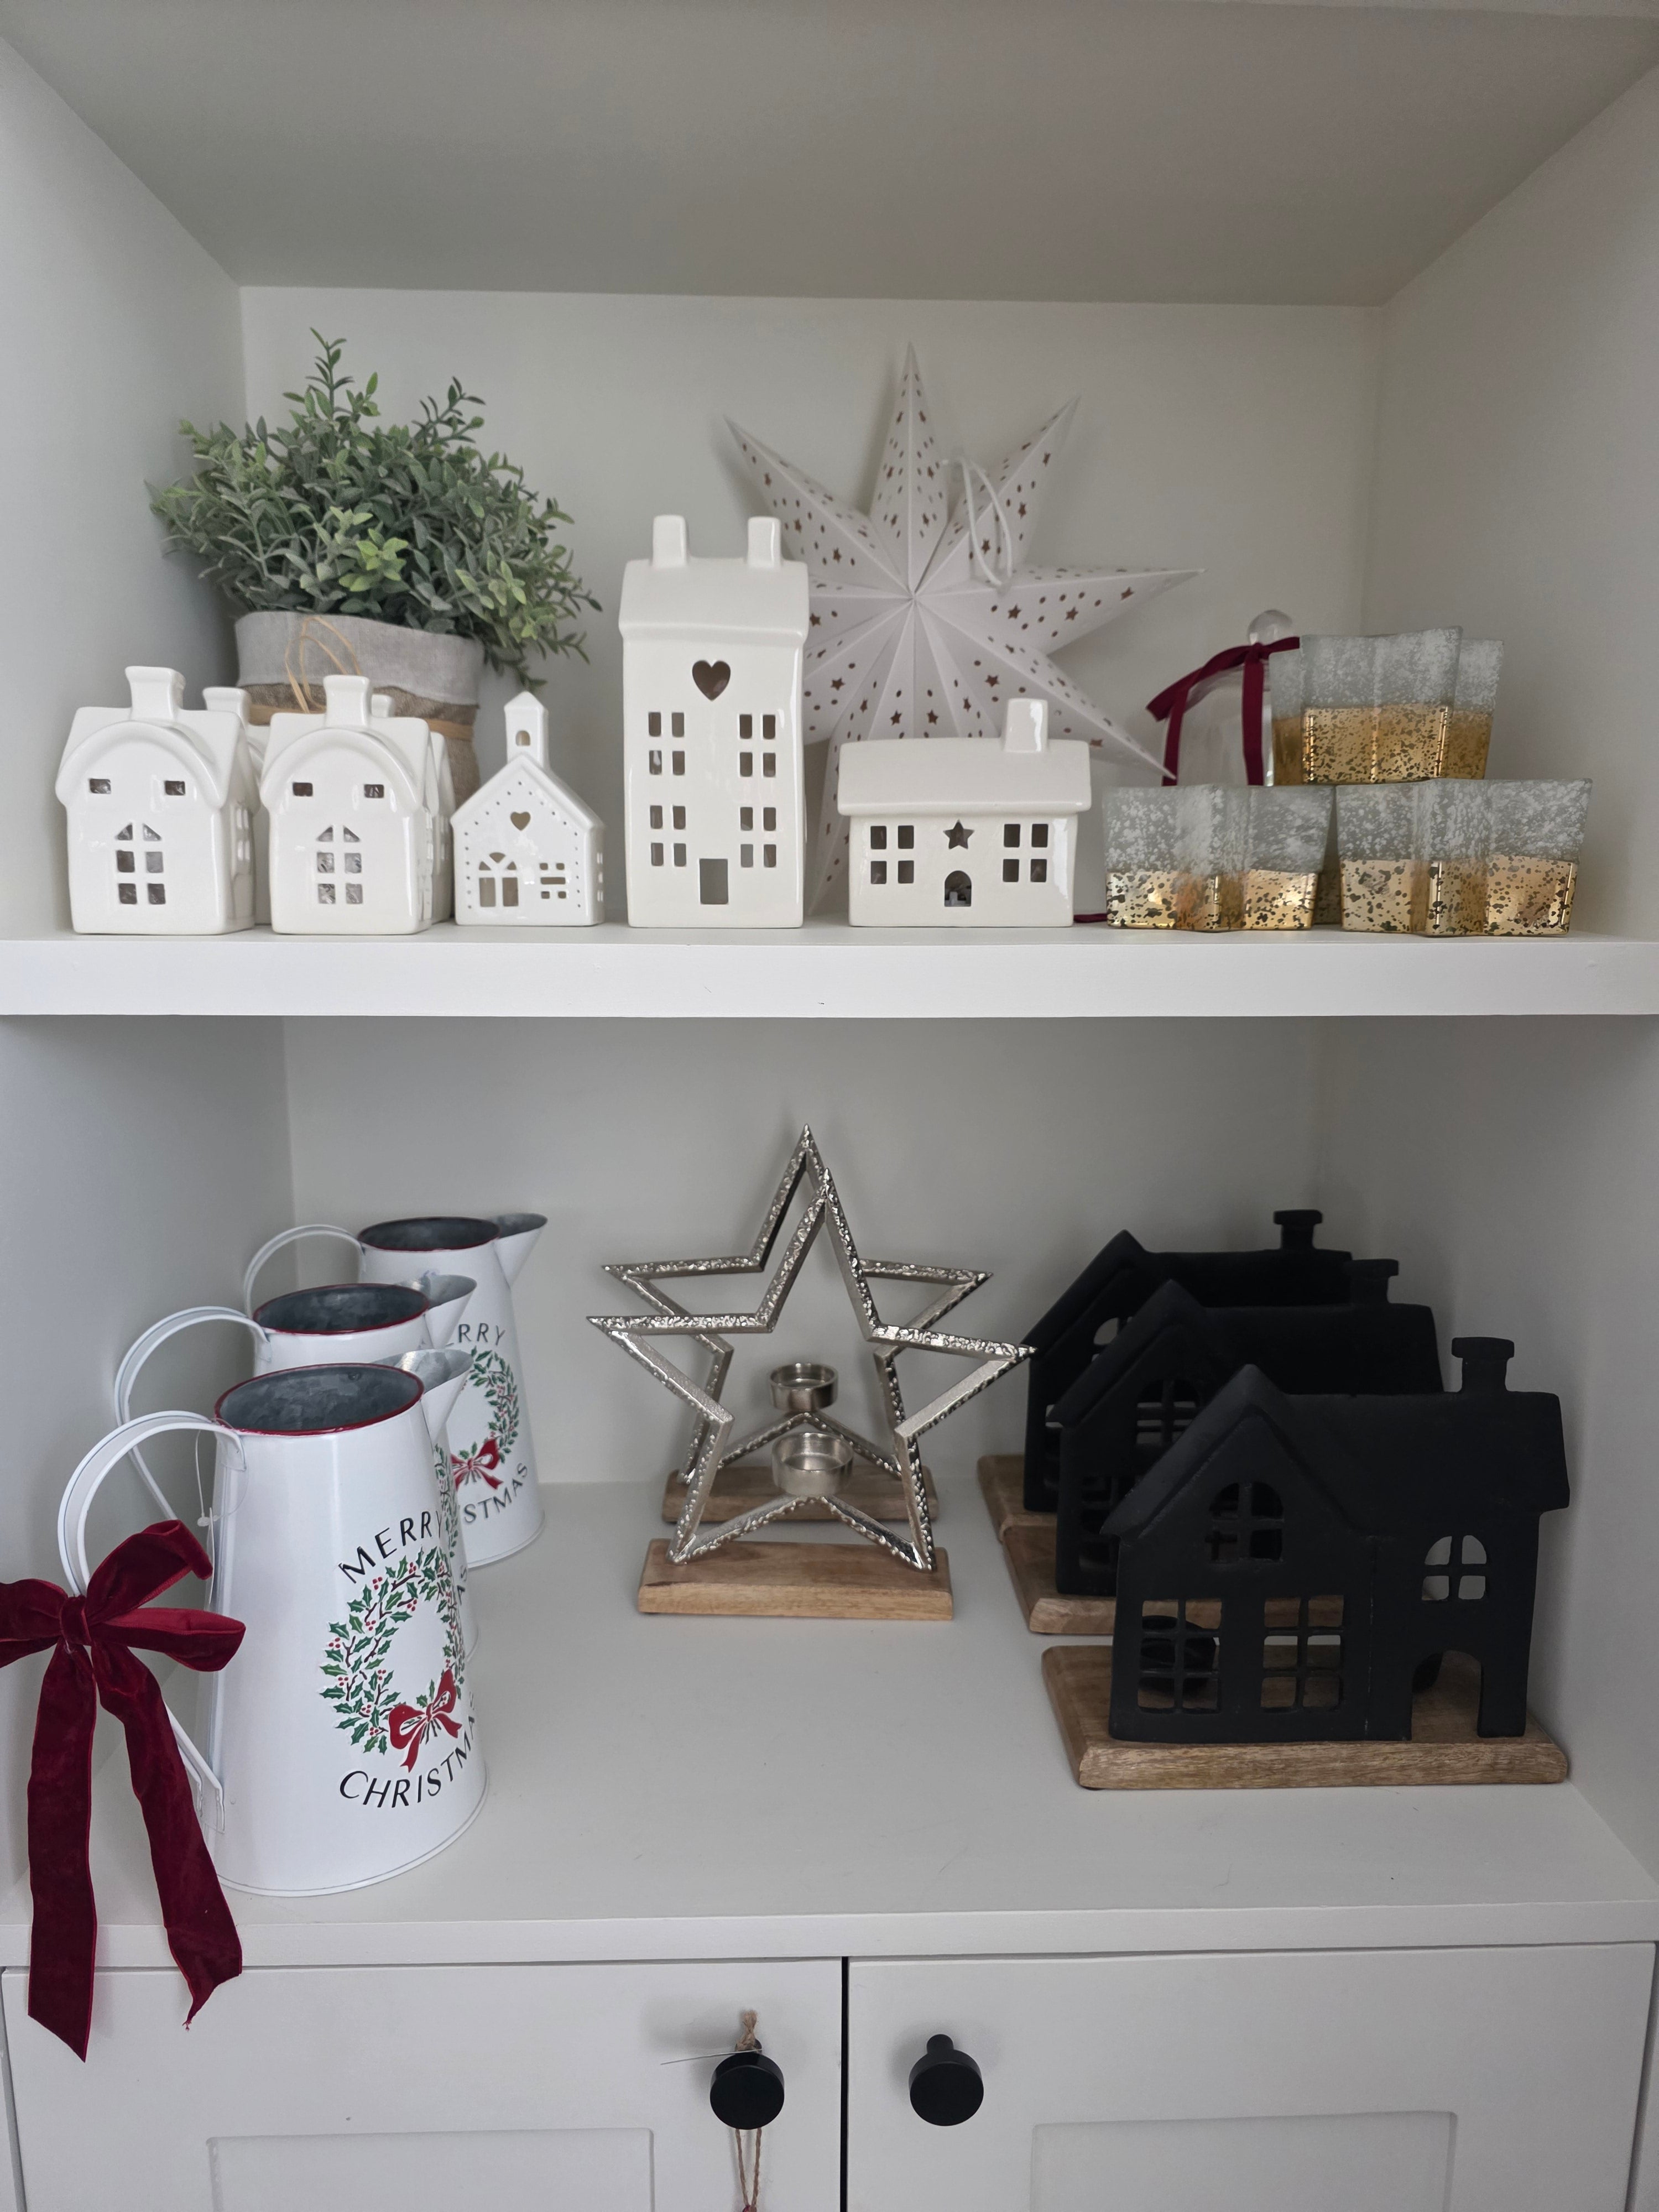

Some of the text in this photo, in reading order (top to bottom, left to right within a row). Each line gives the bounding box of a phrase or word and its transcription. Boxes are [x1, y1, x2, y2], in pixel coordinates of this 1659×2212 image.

[446, 1322, 506, 1347] RRY
[463, 1462, 528, 1524] STMAS
[338, 1510, 442, 1584] MERRY
